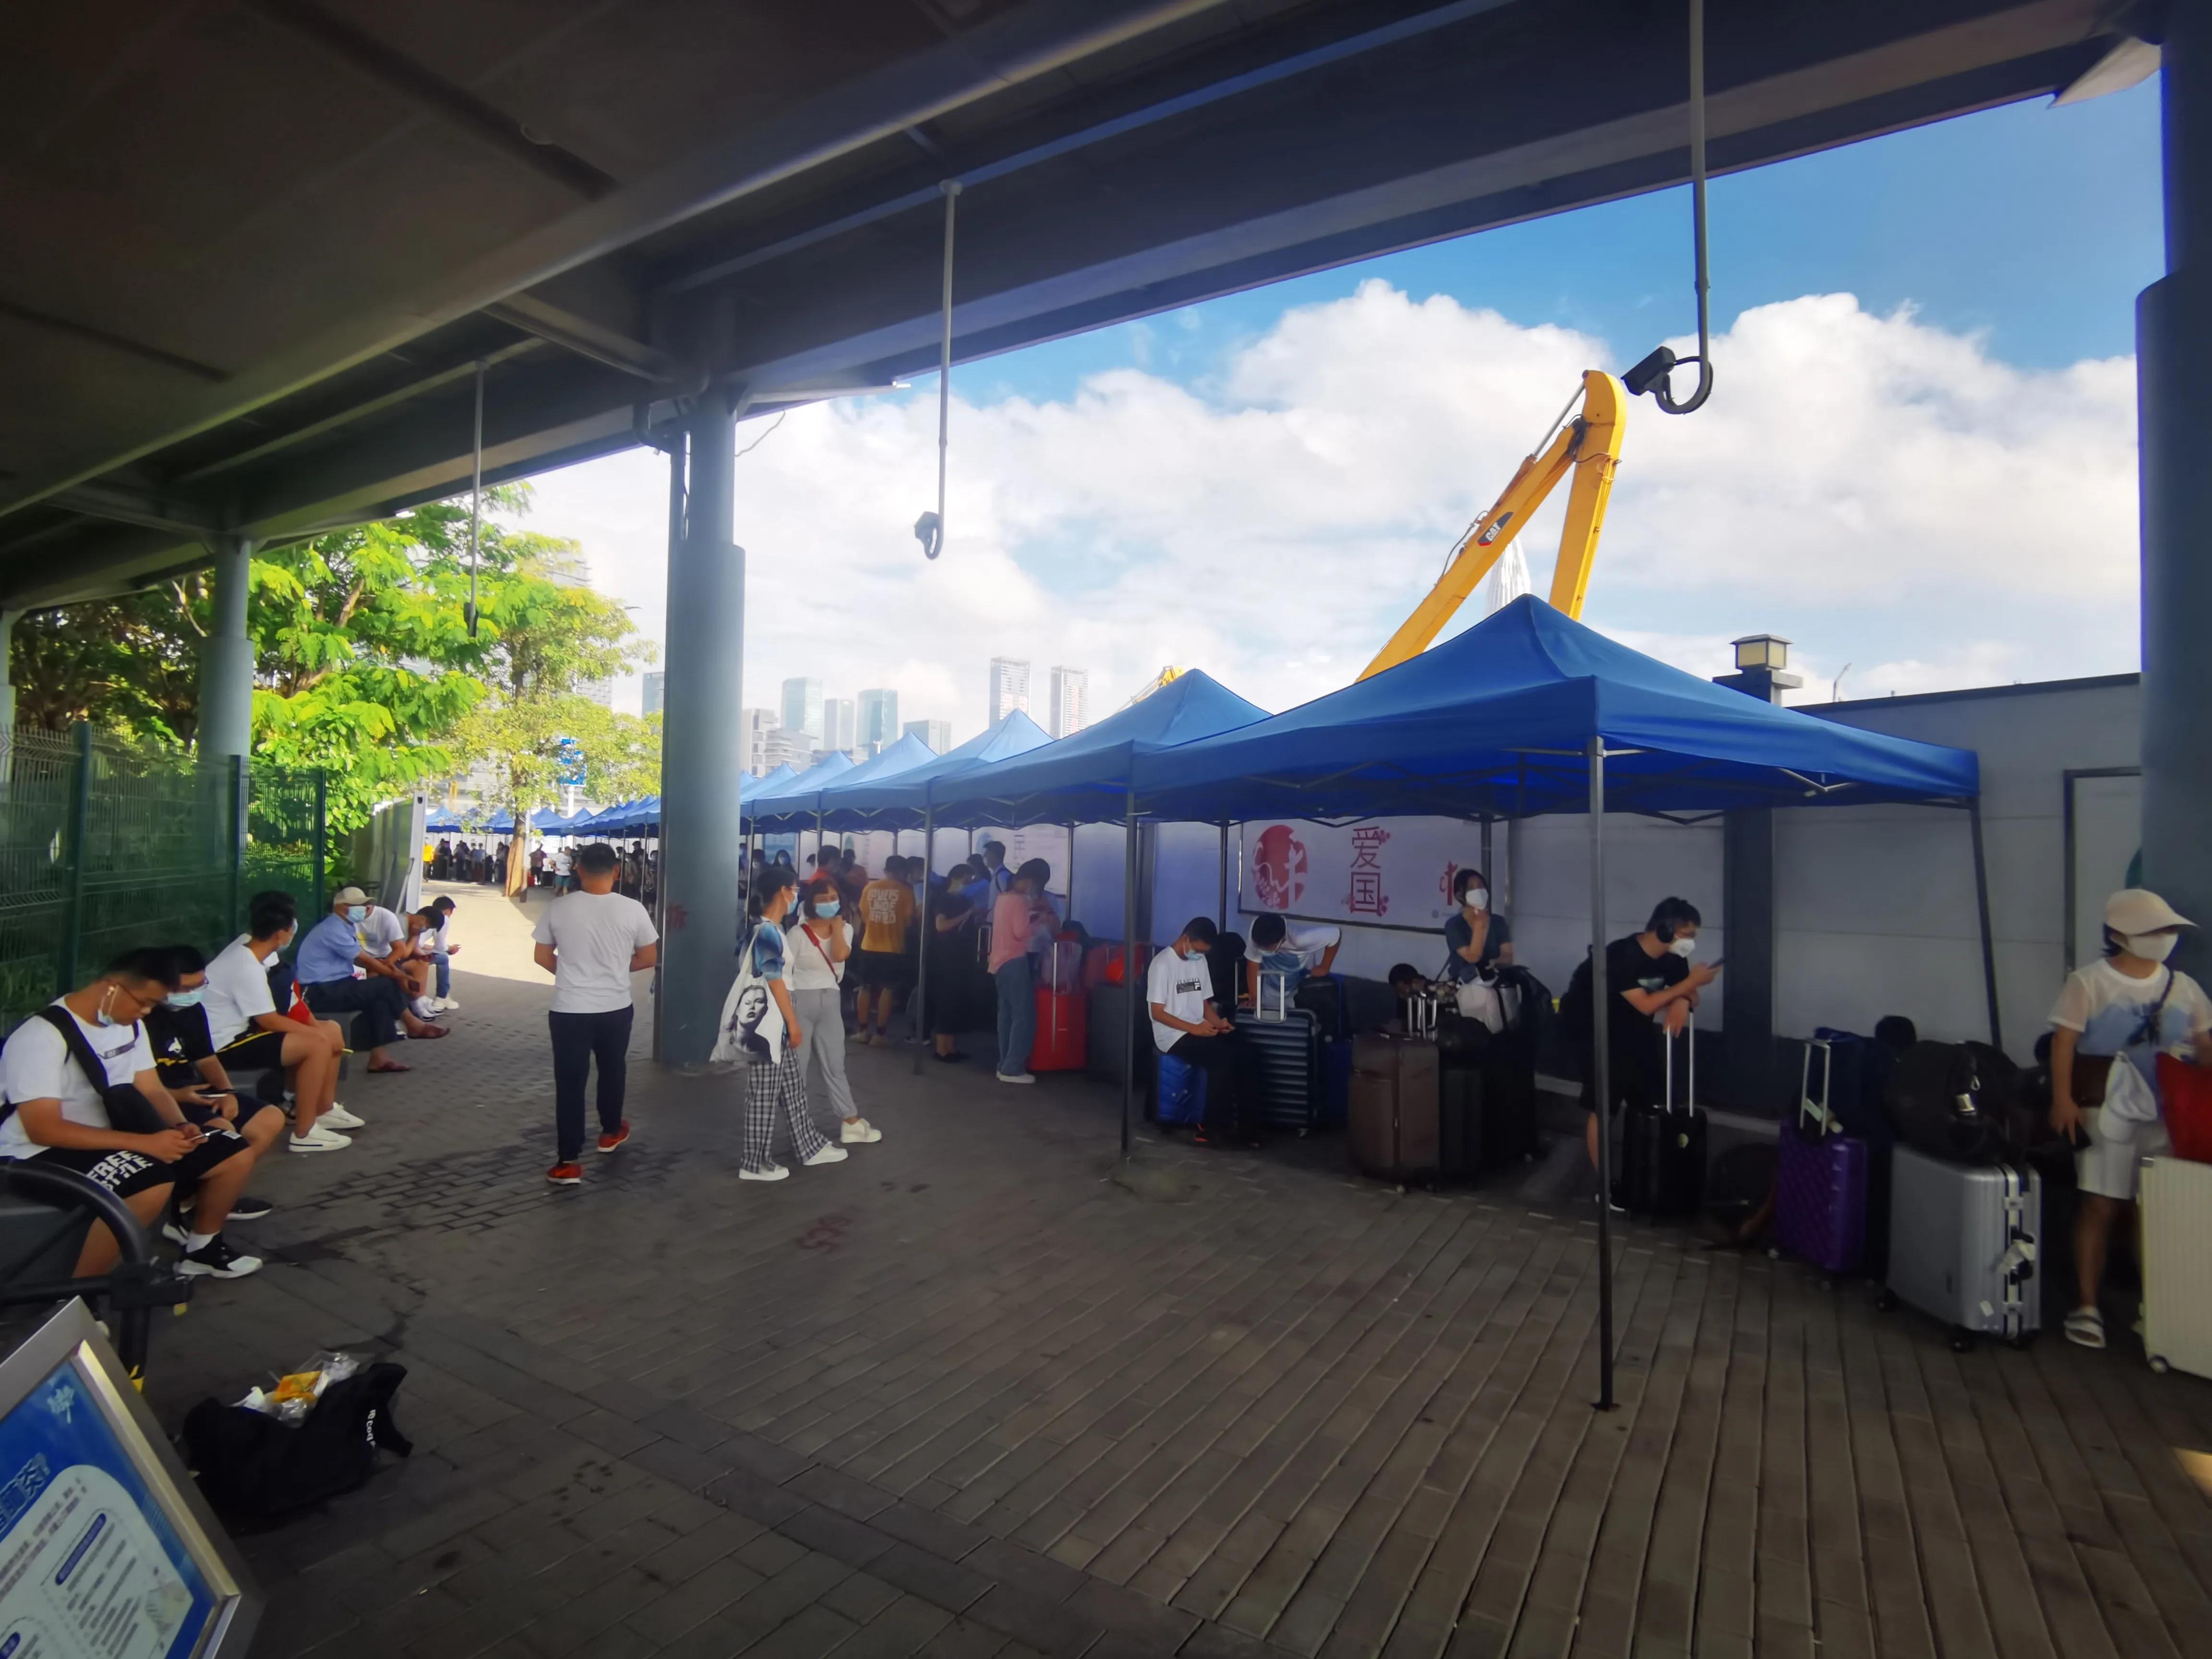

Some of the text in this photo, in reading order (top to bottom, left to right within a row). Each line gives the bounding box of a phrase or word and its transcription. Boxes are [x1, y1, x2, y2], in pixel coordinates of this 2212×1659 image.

[1485, 522, 1501, 541] CAT
[1350, 826, 1381, 914] 爱国
[86, 1150, 138, 1182] FREE
[100, 1157, 154, 1191] STYLE
